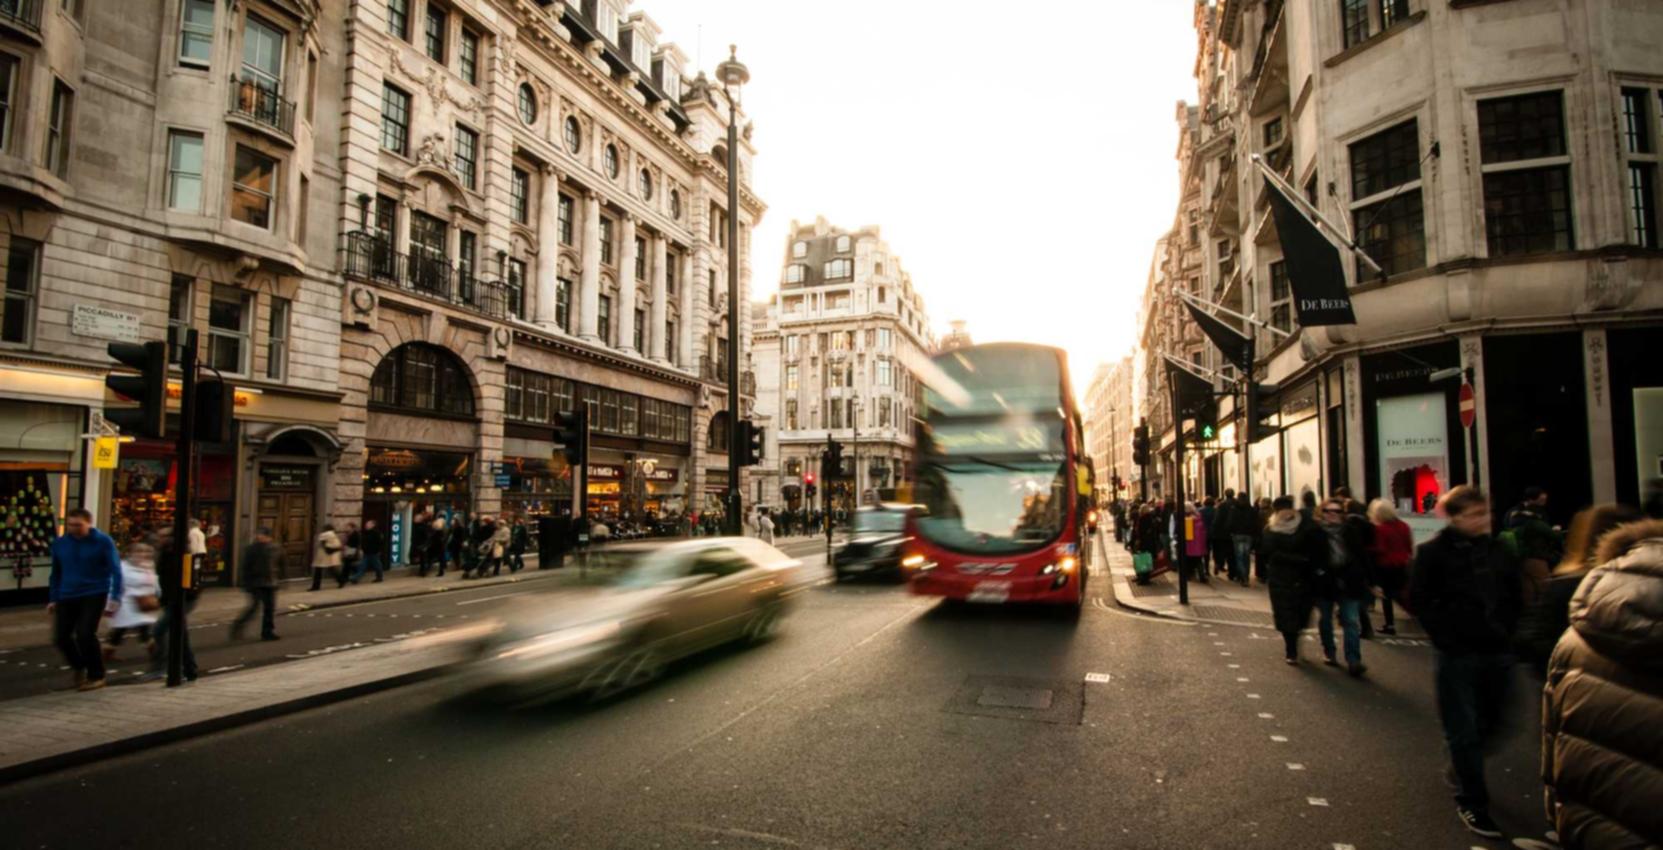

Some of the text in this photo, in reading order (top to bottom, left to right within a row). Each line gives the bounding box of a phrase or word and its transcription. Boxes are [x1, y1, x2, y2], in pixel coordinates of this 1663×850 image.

[1301, 299, 1320, 311] DE
[78, 306, 124, 319] PICCADILLY
[1404, 437, 1442, 446] BEERS
[391, 512, 400, 563] MONEY
